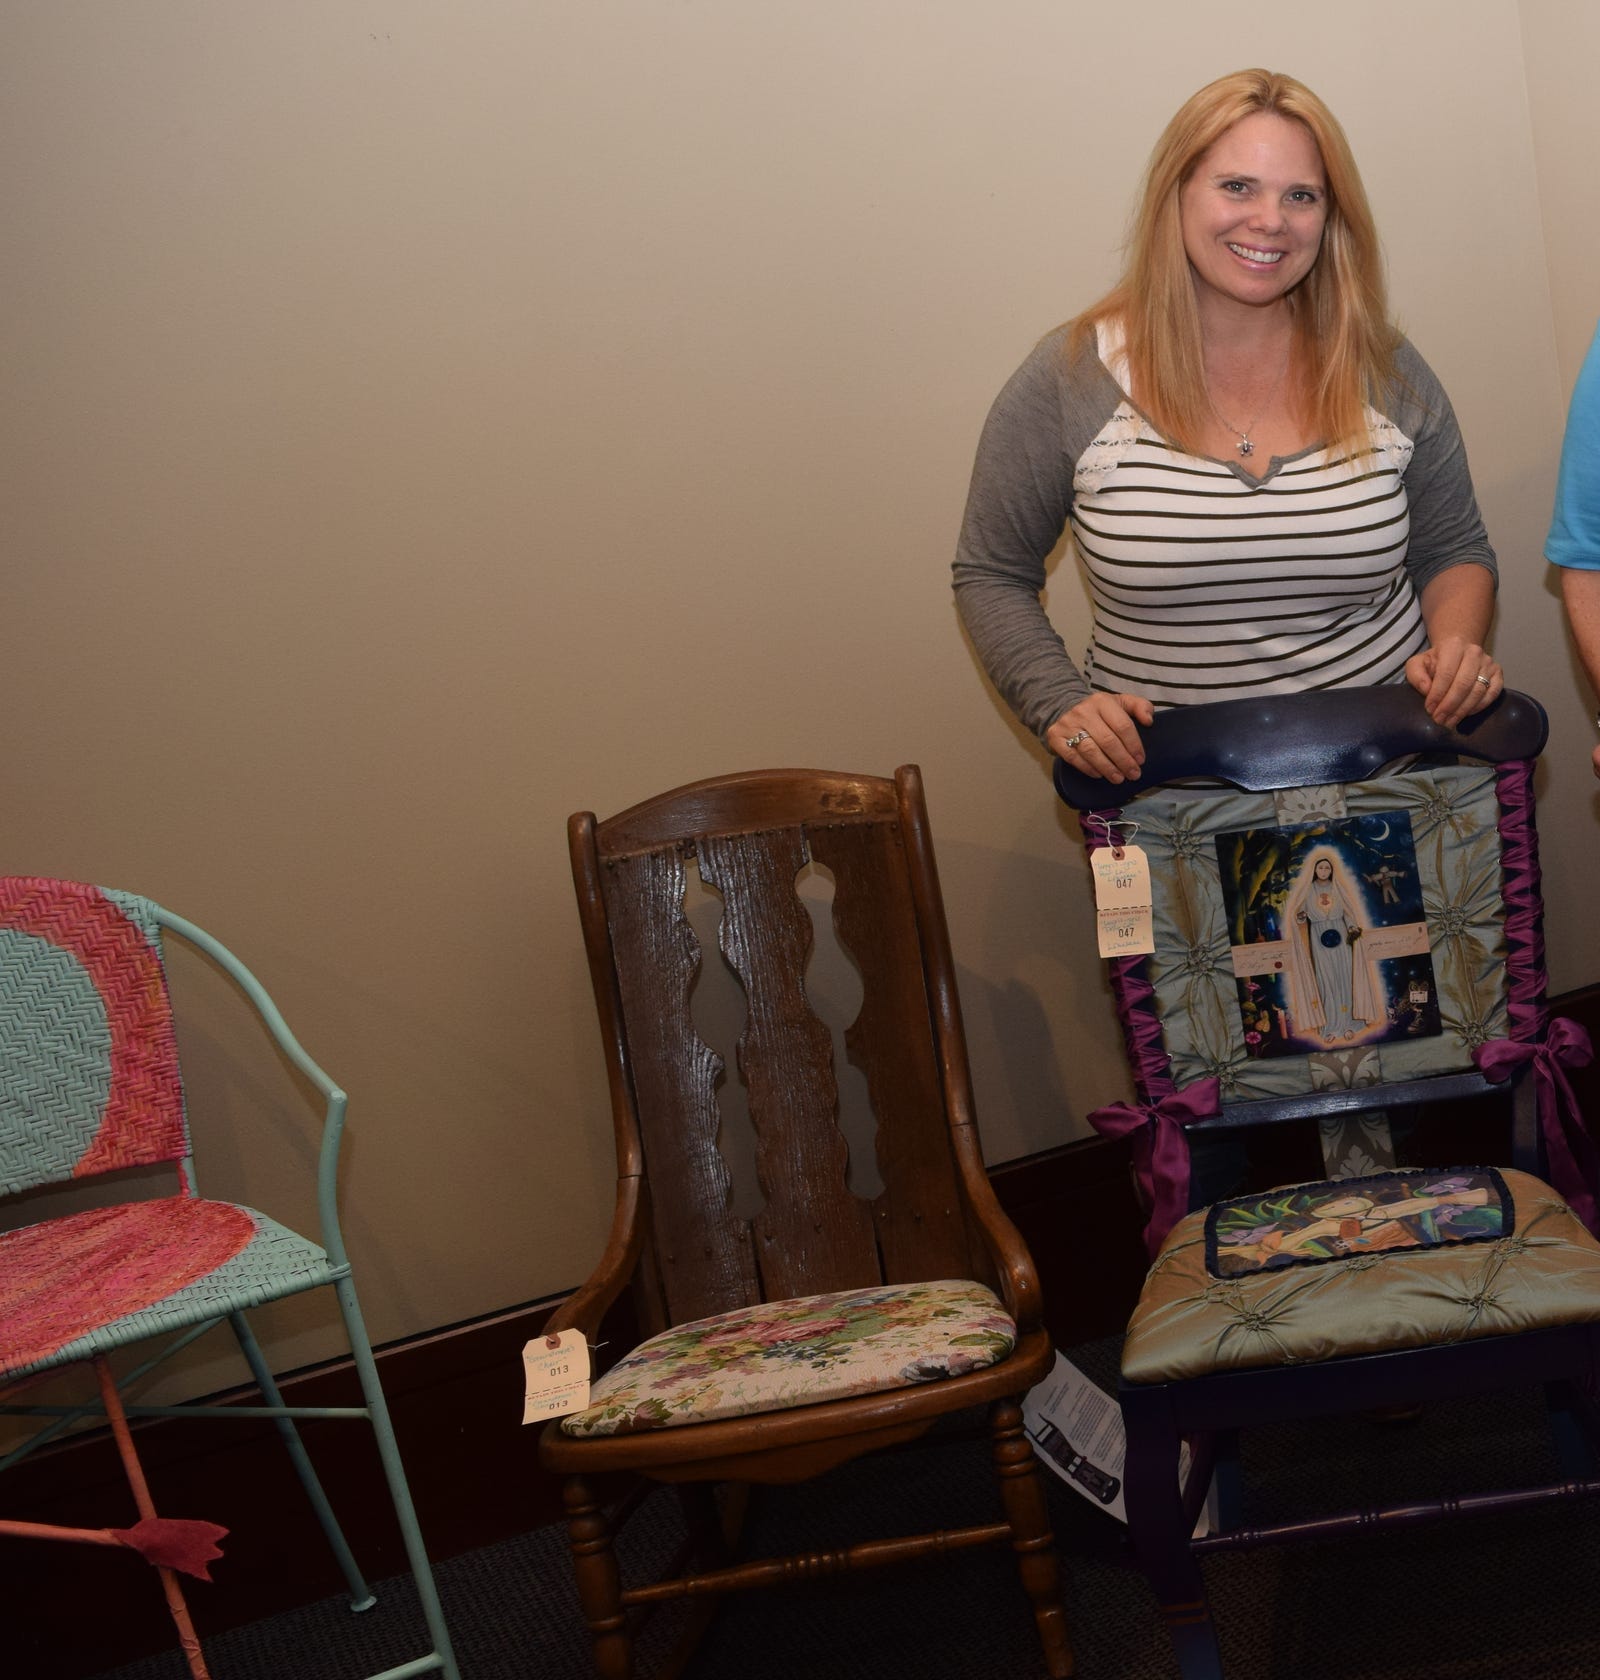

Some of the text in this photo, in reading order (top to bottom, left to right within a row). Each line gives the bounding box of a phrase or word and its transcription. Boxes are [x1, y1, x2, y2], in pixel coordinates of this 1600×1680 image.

[1116, 879, 1132, 888] 047
[1118, 928, 1134, 938] 047
[550, 1365, 568, 1376] 013
[549, 1400, 568, 1410] 013
